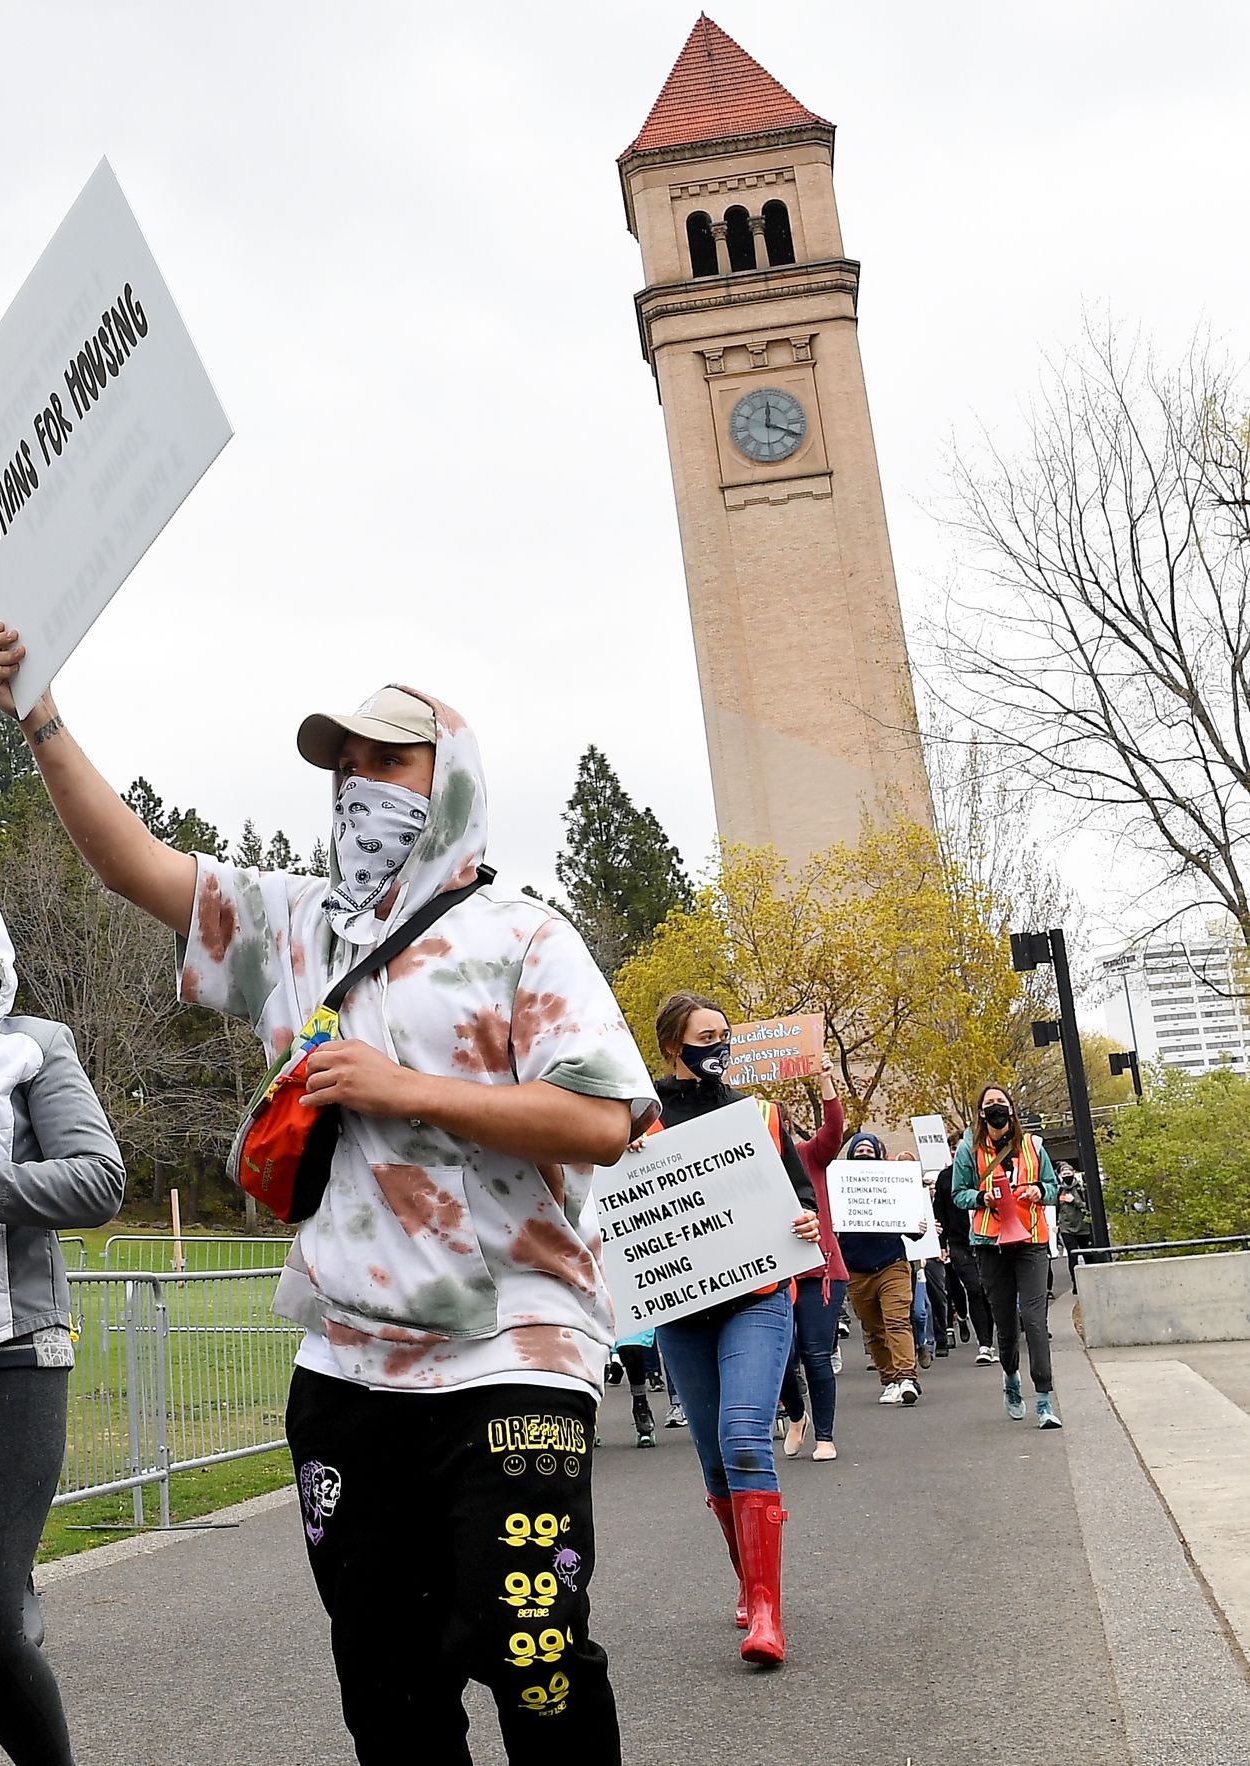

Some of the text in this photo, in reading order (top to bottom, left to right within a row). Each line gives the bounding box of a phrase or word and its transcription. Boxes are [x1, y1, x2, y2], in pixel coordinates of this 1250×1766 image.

[32, 391, 73, 468] FOR
[63, 282, 149, 421] HOUSING
[627, 1153, 683, 1180] WE MARCH FOR
[656, 1142, 756, 1191] PROTECTIONS
[623, 1209, 735, 1263] SINGLE-FAMILY
[634, 1256, 693, 1290] ZONING
[698, 1254, 778, 1296] FACILITIES
[488, 1414, 587, 1455] DREAMS
[517, 1607, 550, 1619] sense
